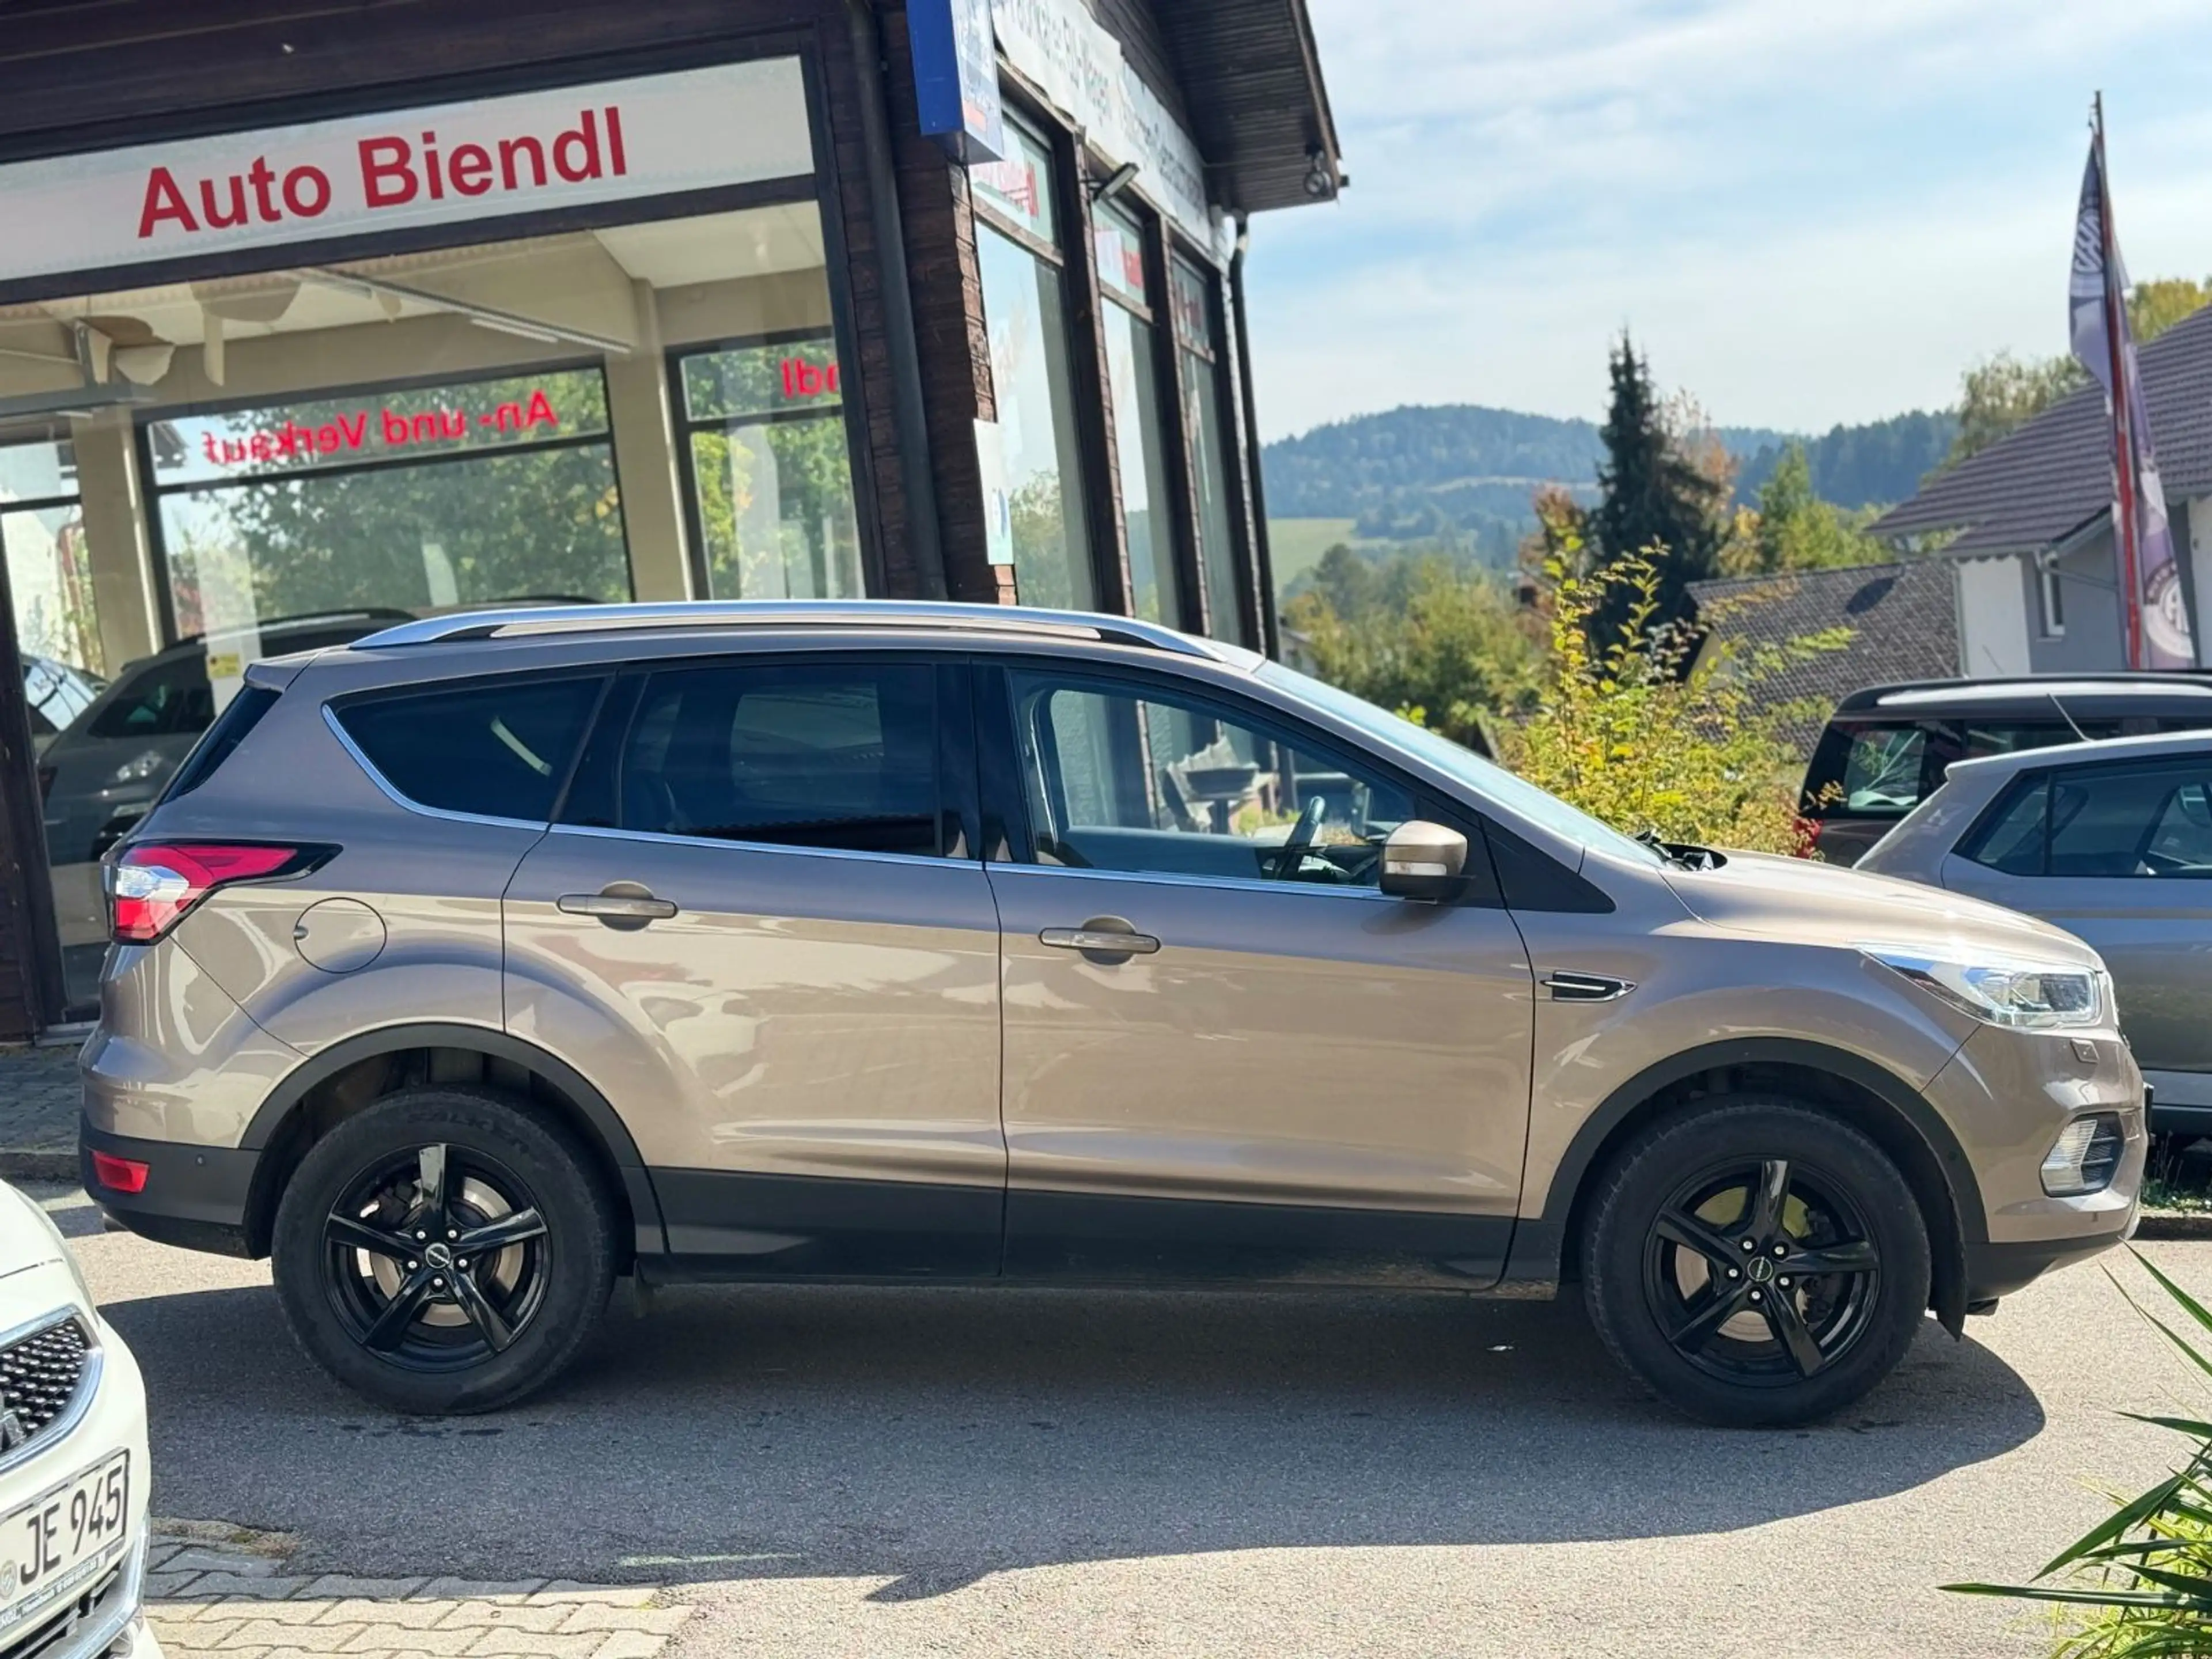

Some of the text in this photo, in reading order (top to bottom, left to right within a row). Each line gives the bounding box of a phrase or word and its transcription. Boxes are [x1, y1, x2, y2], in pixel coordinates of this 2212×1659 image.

[139, 107, 626, 237] Auto Biendl
[21, 1465, 122, 1585] JE 945
